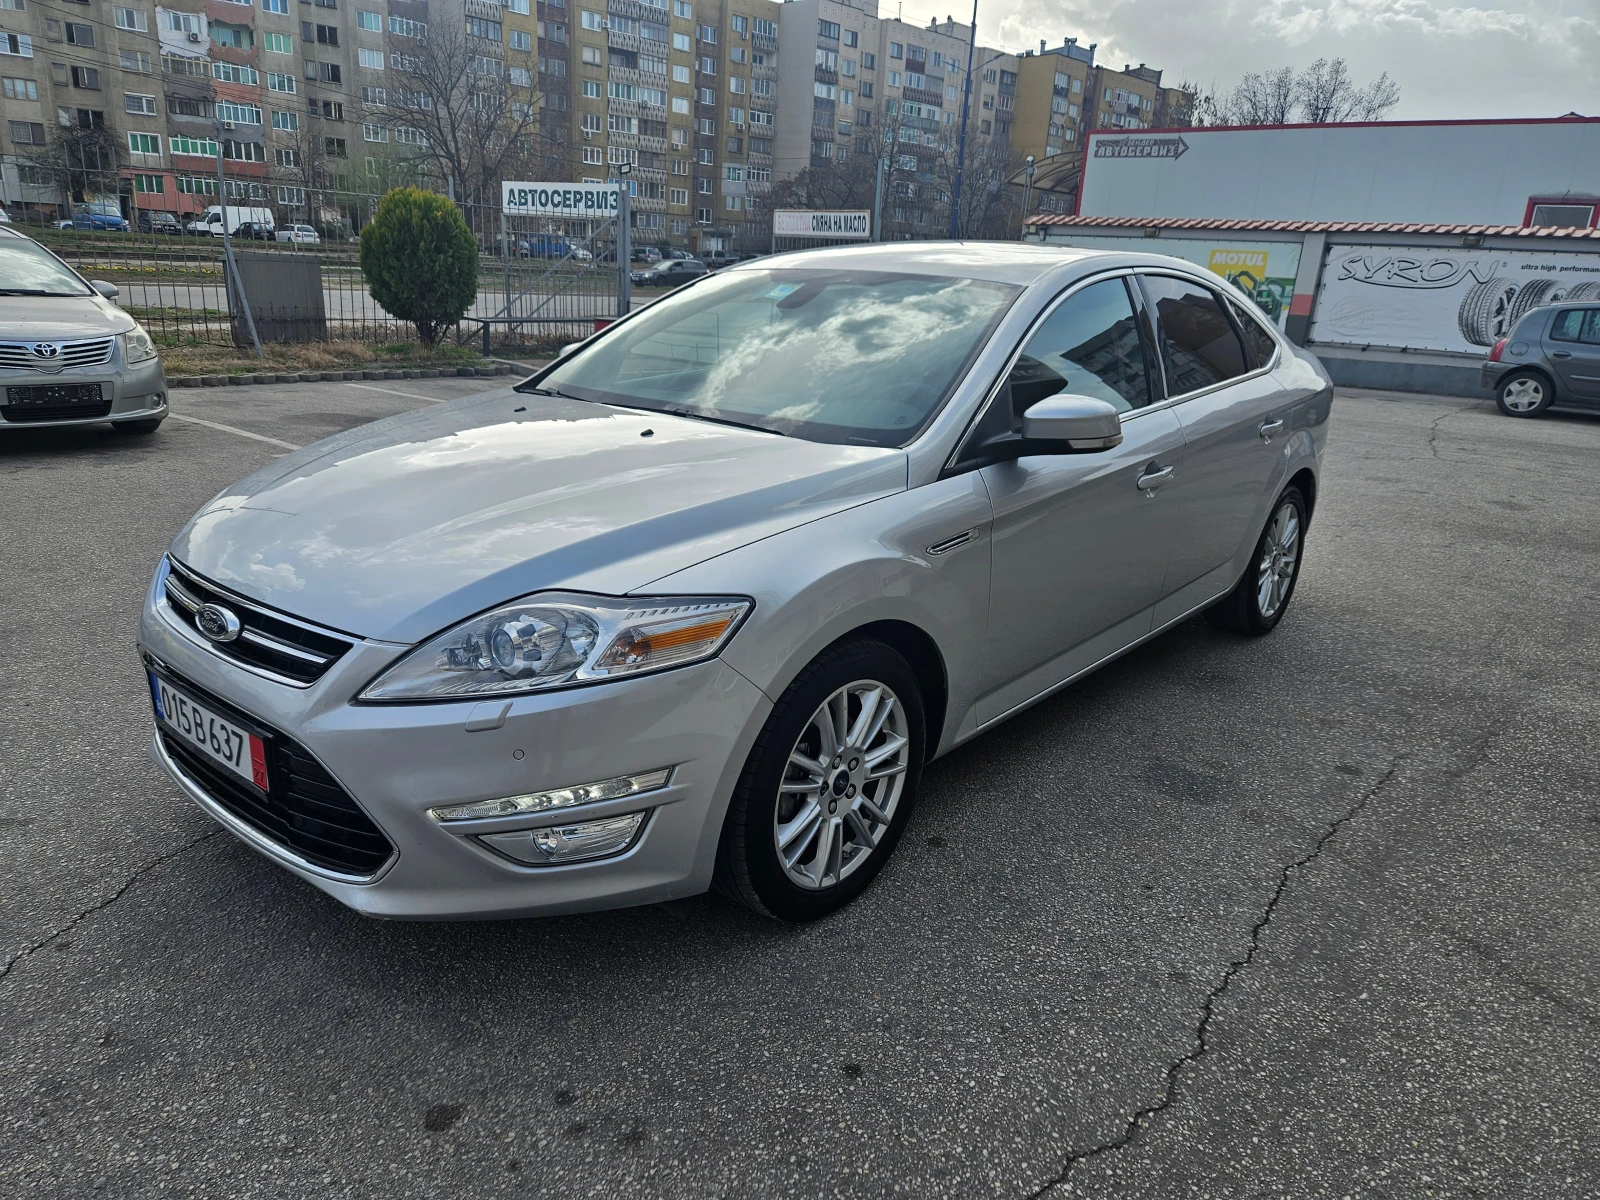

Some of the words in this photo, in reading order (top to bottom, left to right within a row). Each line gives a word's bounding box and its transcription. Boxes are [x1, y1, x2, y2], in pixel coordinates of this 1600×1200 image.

[1097, 145, 1176, 157] АВТОСЕРВИЗ
[507, 188, 618, 210] АВТОСЕРВИЗ
[811, 214, 833, 232] СМЯНА
[833, 214, 843, 232] НА
[843, 215, 867, 233] МАСЛО
[1211, 251, 1265, 265] MOTUL
[1338, 255, 1500, 289] SYRON
[1540, 264, 1557, 273] high
[1559, 265, 1600, 274] performan
